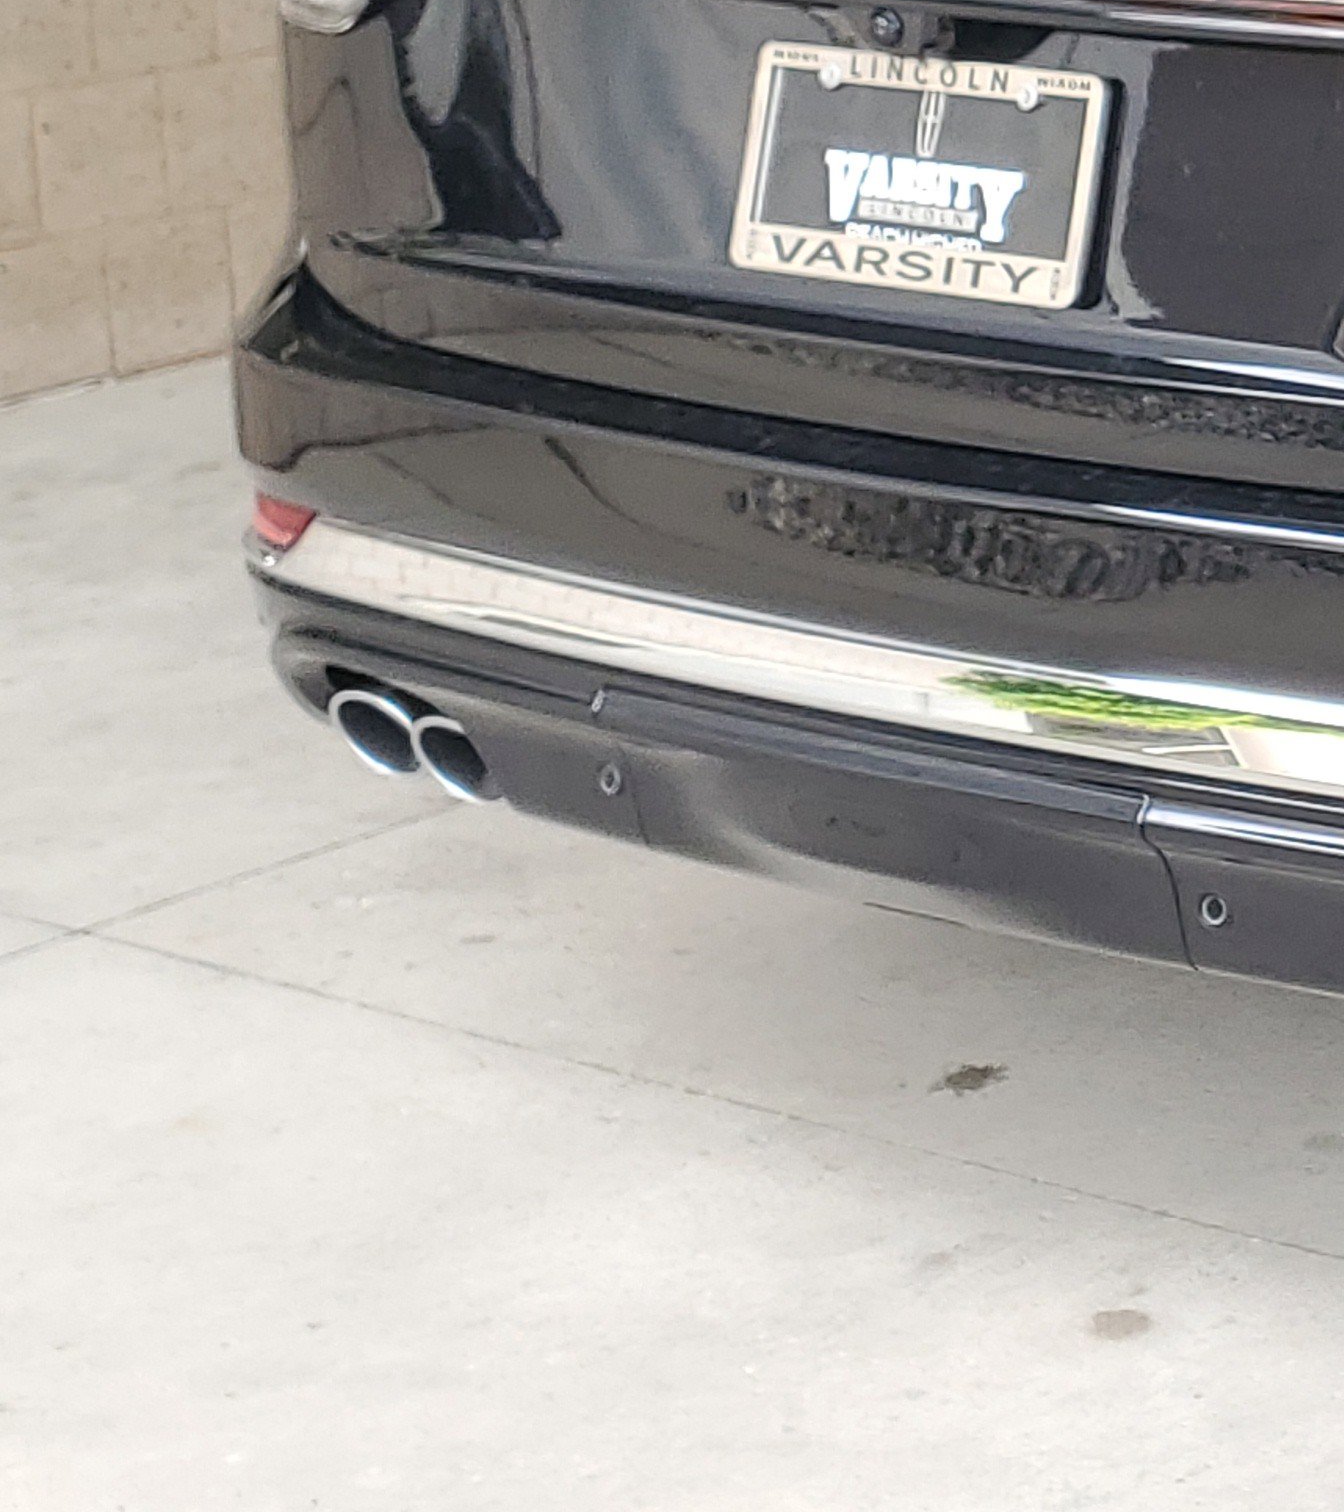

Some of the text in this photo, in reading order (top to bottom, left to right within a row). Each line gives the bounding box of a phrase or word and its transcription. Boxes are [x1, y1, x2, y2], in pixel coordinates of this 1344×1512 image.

[851, 54, 1009, 93] LINCOLN
[825, 148, 1025, 243] VARSITY
[866, 203, 965, 227] LINCOLN
[772, 234, 1037, 293] VARSITY
